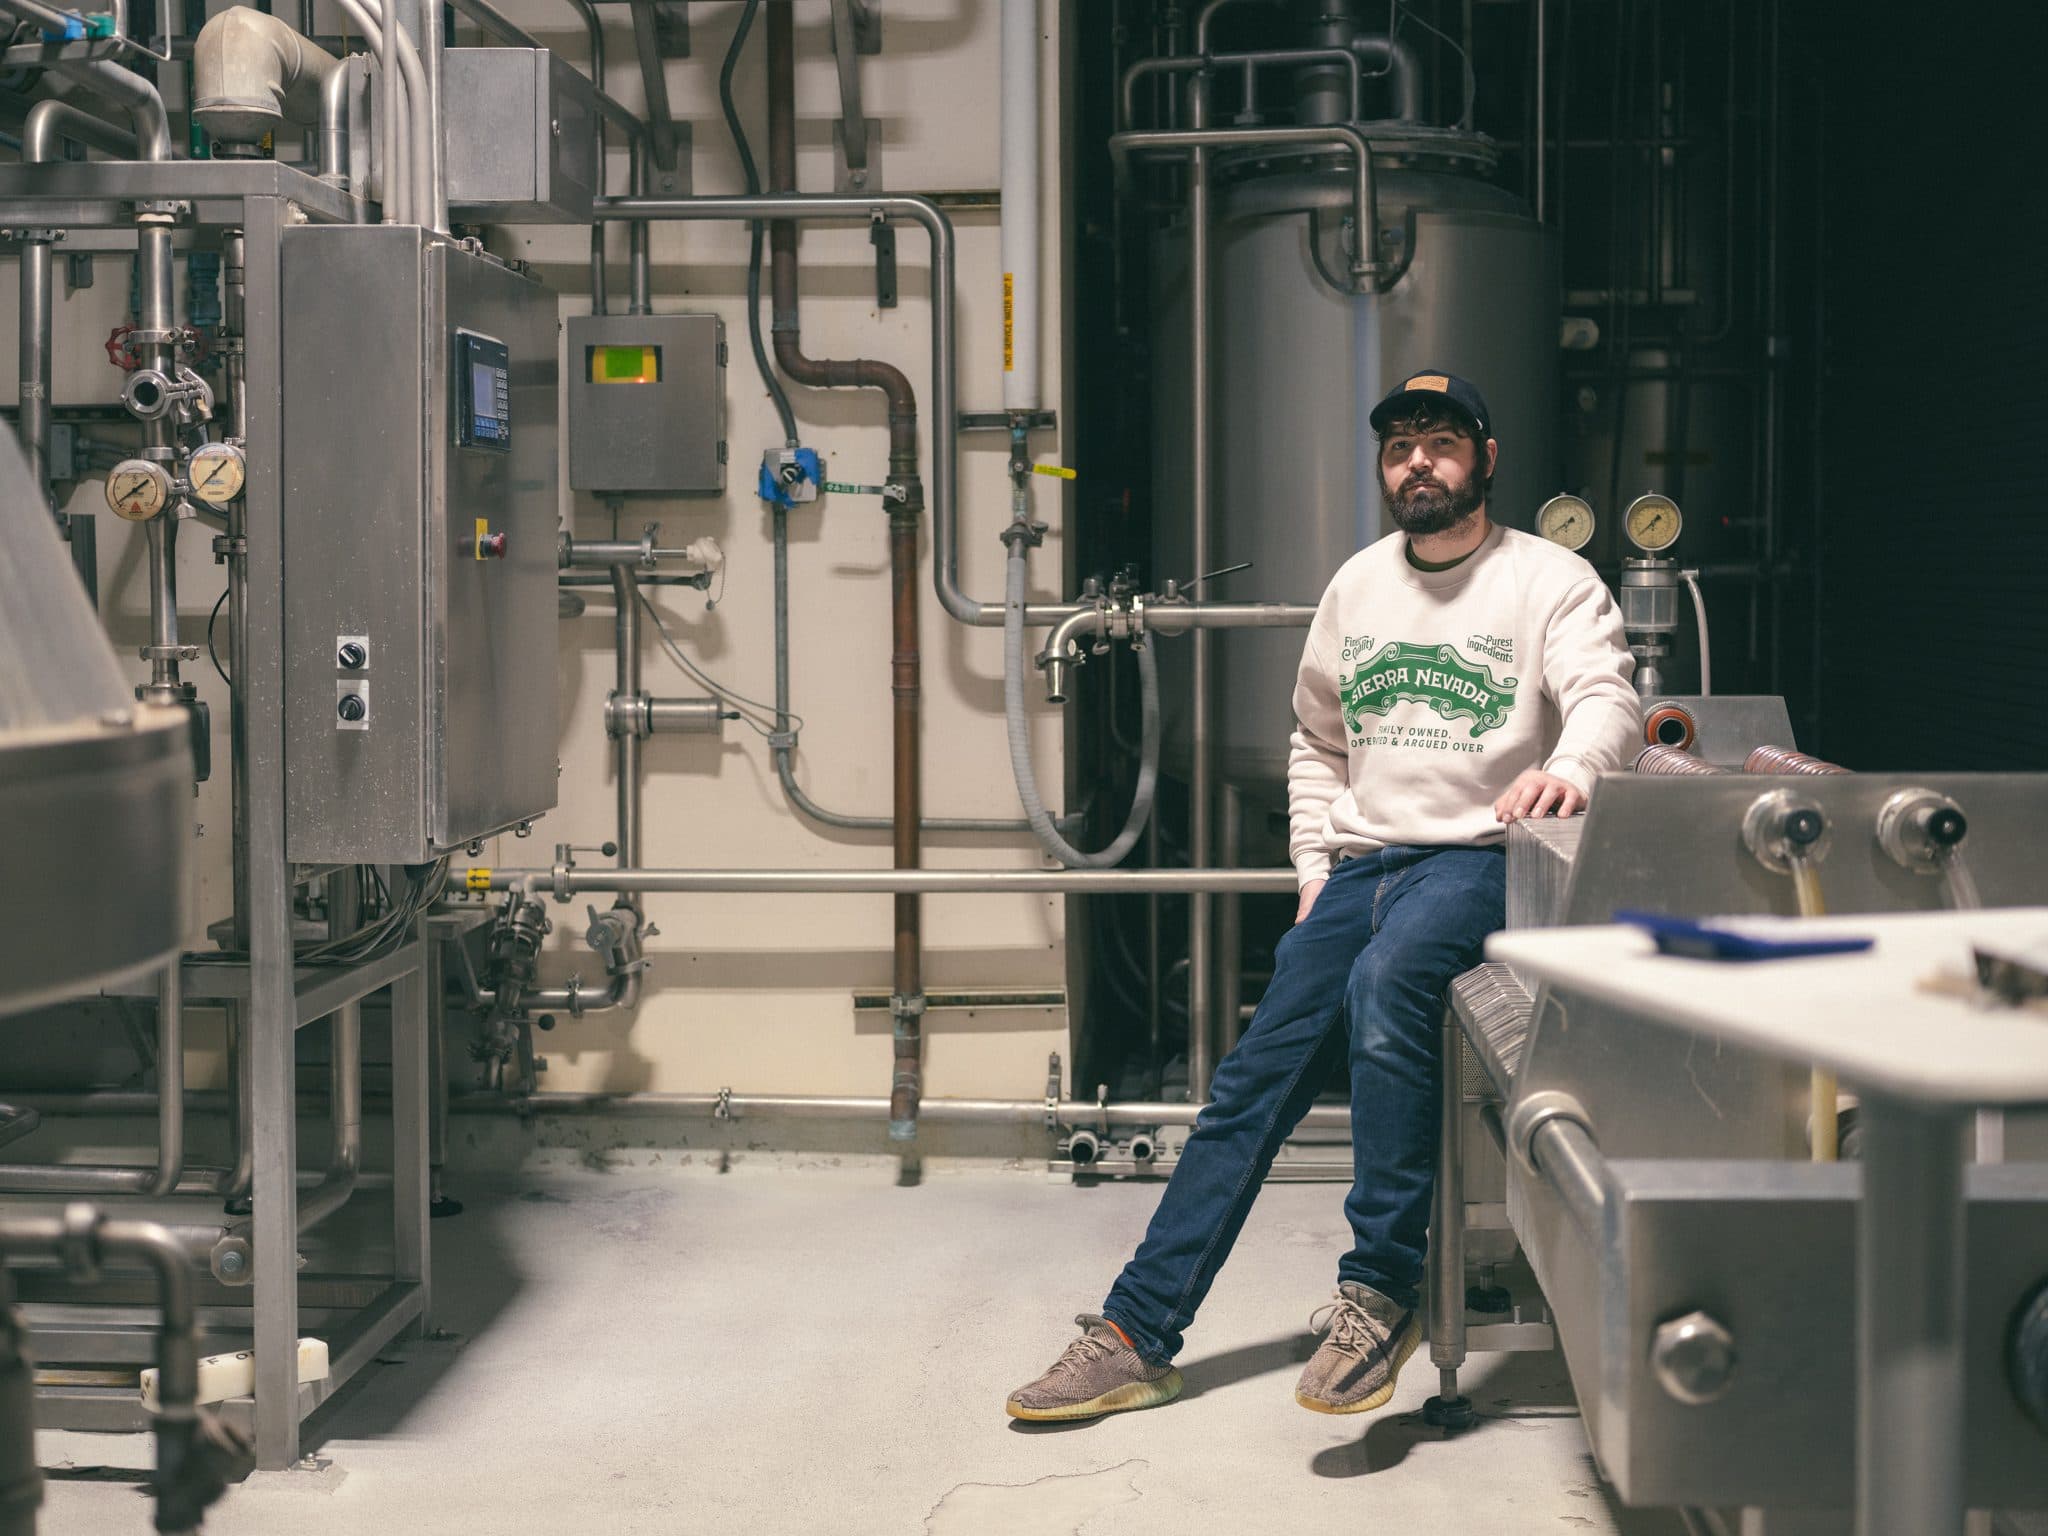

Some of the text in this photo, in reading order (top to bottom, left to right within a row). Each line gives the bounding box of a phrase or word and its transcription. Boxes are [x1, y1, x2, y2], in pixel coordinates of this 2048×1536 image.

[1003, 324, 1012, 351] SERVICE
[1343, 636, 1375, 660] Qality
[1466, 637, 1514, 663] Ingredients
[1481, 634, 1512, 648] Purest
[1351, 667, 1410, 705] SIERRA
[1391, 737, 1399, 746] &
[1403, 738, 1448, 749] ARGUED
[1452, 742, 1484, 753] OVER
